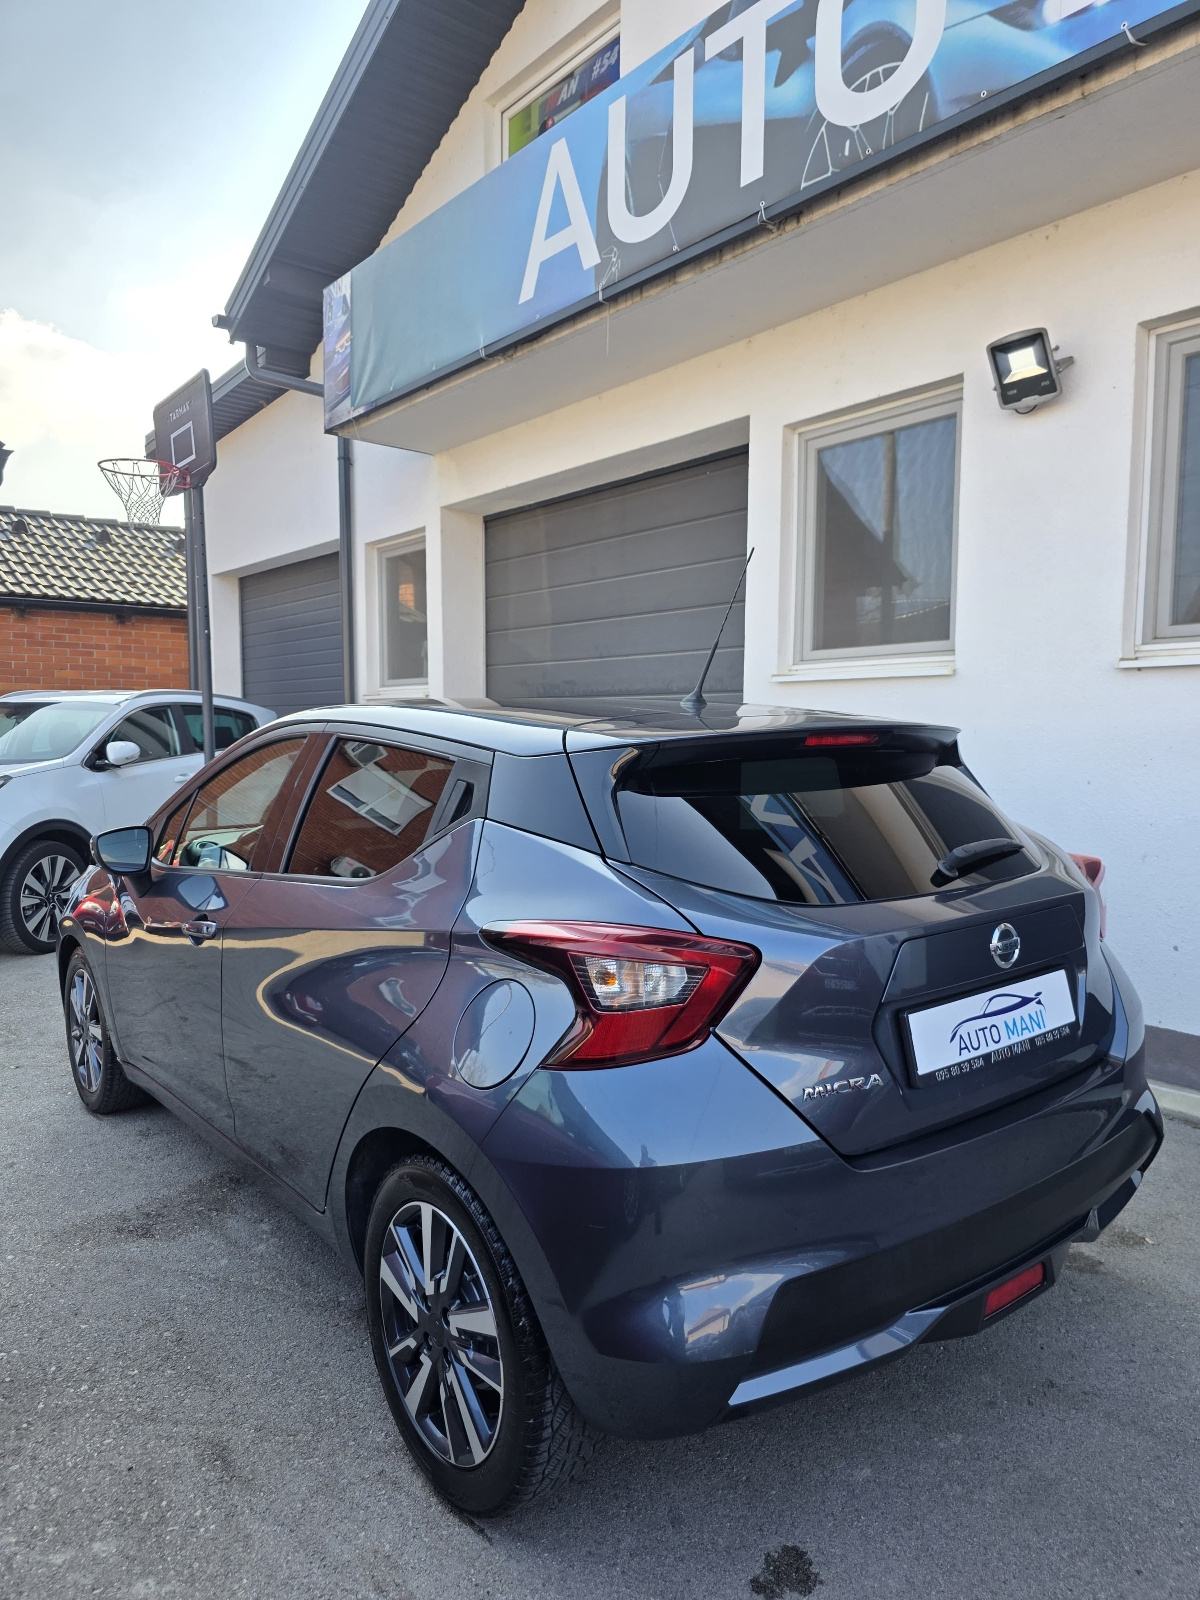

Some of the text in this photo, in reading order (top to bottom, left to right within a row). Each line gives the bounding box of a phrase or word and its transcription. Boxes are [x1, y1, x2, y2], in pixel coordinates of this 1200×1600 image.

[518, 0, 946, 304] AUTO
[958, 1009, 1046, 1056] AUTO MANI
[935, 1069, 950, 1081] 095
[991, 1047, 1011, 1064] AUTO
[1011, 1039, 1031, 1055] MANI
[802, 1073, 884, 1101] MICRA
